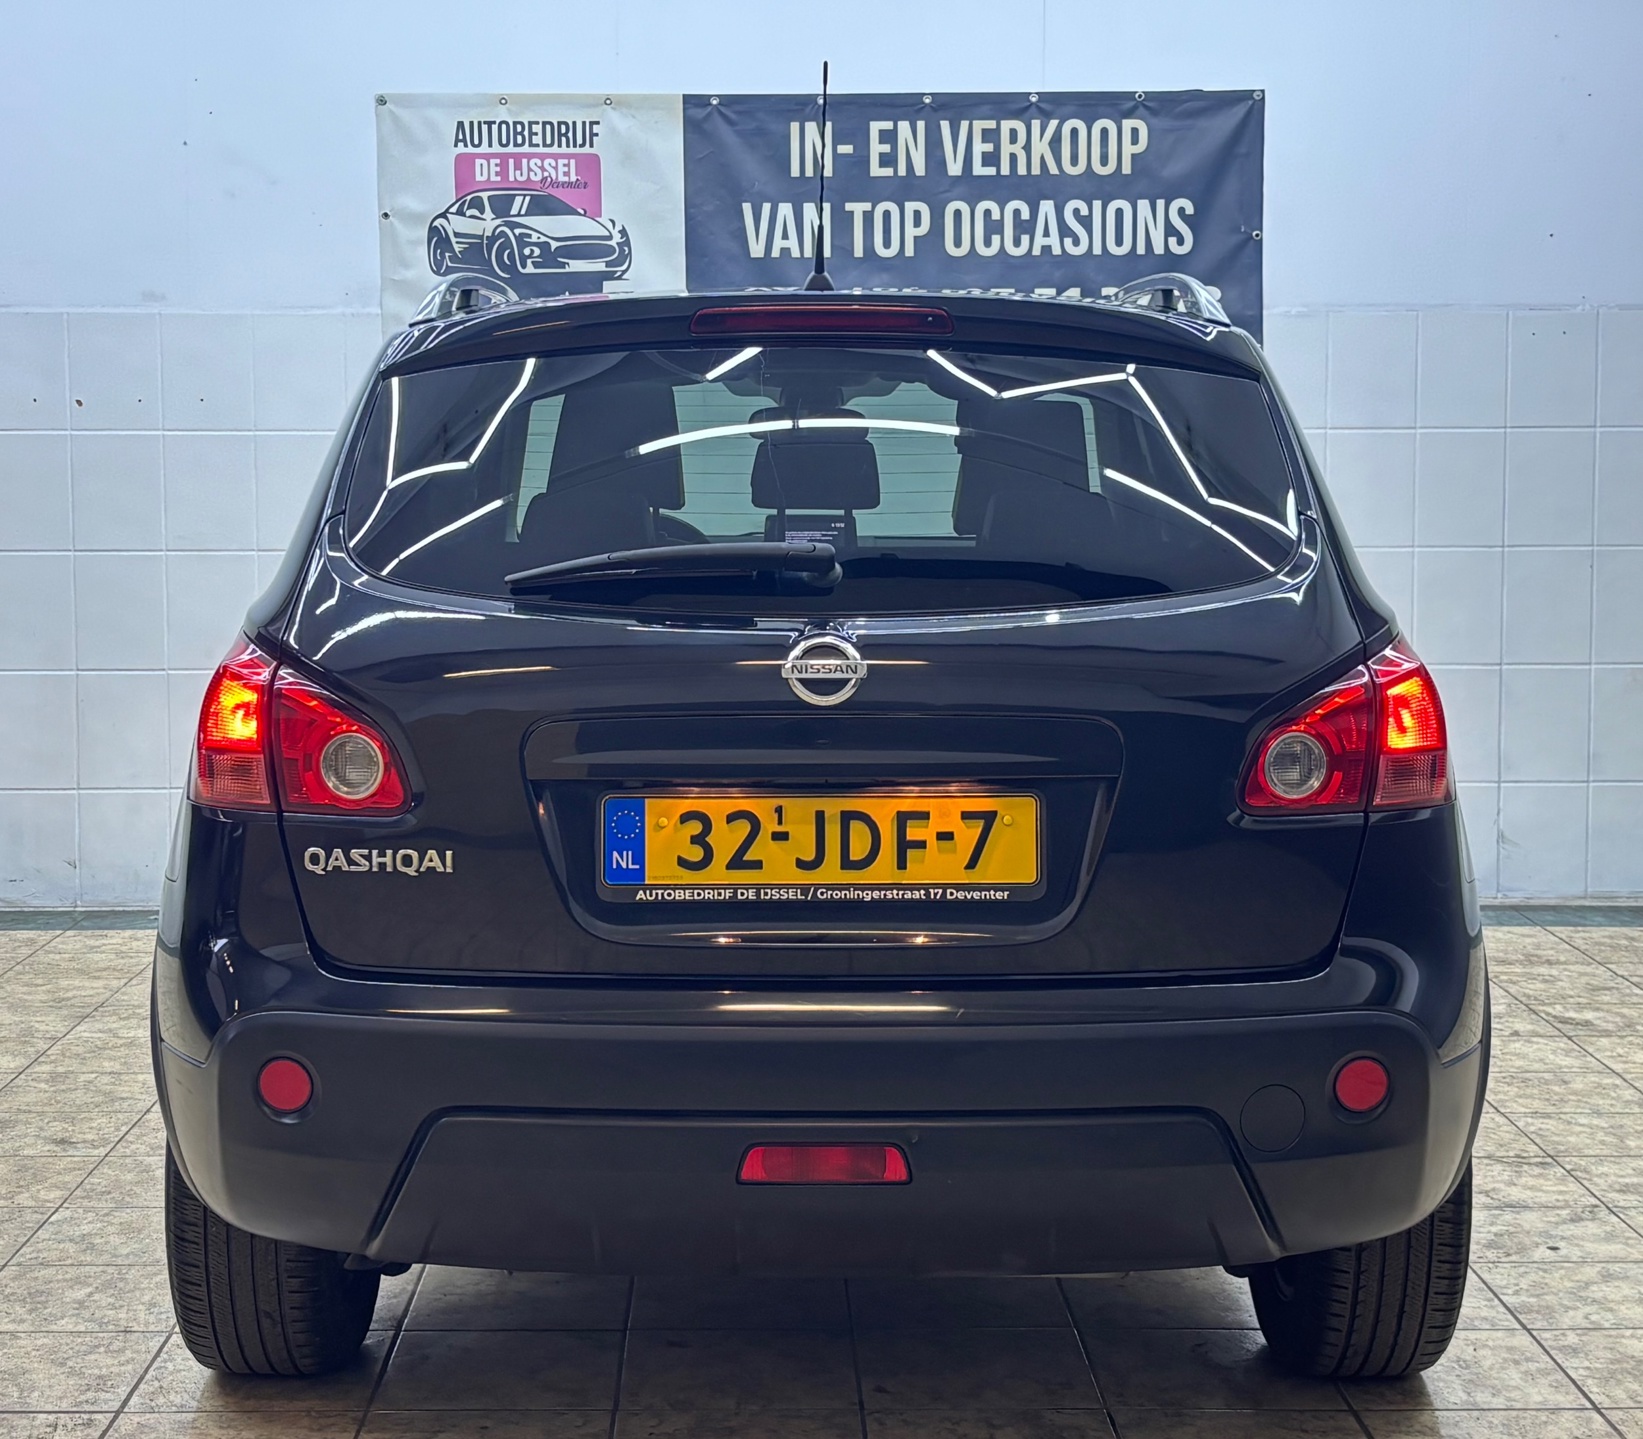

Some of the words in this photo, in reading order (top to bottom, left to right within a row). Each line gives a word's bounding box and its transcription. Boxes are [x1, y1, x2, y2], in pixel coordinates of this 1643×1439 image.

[453, 120, 600, 148] AUTOBEDRIJF
[790, 121, 854, 178] IN-
[869, 120, 926, 177] EN
[940, 118, 1149, 176] VERKOOP
[475, 158, 501, 181] DE
[508, 158, 581, 182] IJSSEL
[539, 175, 589, 190] Deventer
[742, 202, 831, 258] VAN
[845, 200, 931, 258] TOP
[944, 198, 1195, 258] OCCASIONS
[791, 664, 858, 675] NISSAN
[304, 847, 453, 876] QASHQAI
[612, 851, 640, 869] NL
[635, 889, 734, 901] AUTOBEDRIJF
[737, 888, 757, 900] DE
[760, 888, 805, 900] IJSSEL
[817, 887, 926, 902] Groningerstraat
[929, 888, 943, 900] 17
[946, 888, 1009, 900] Deventer
